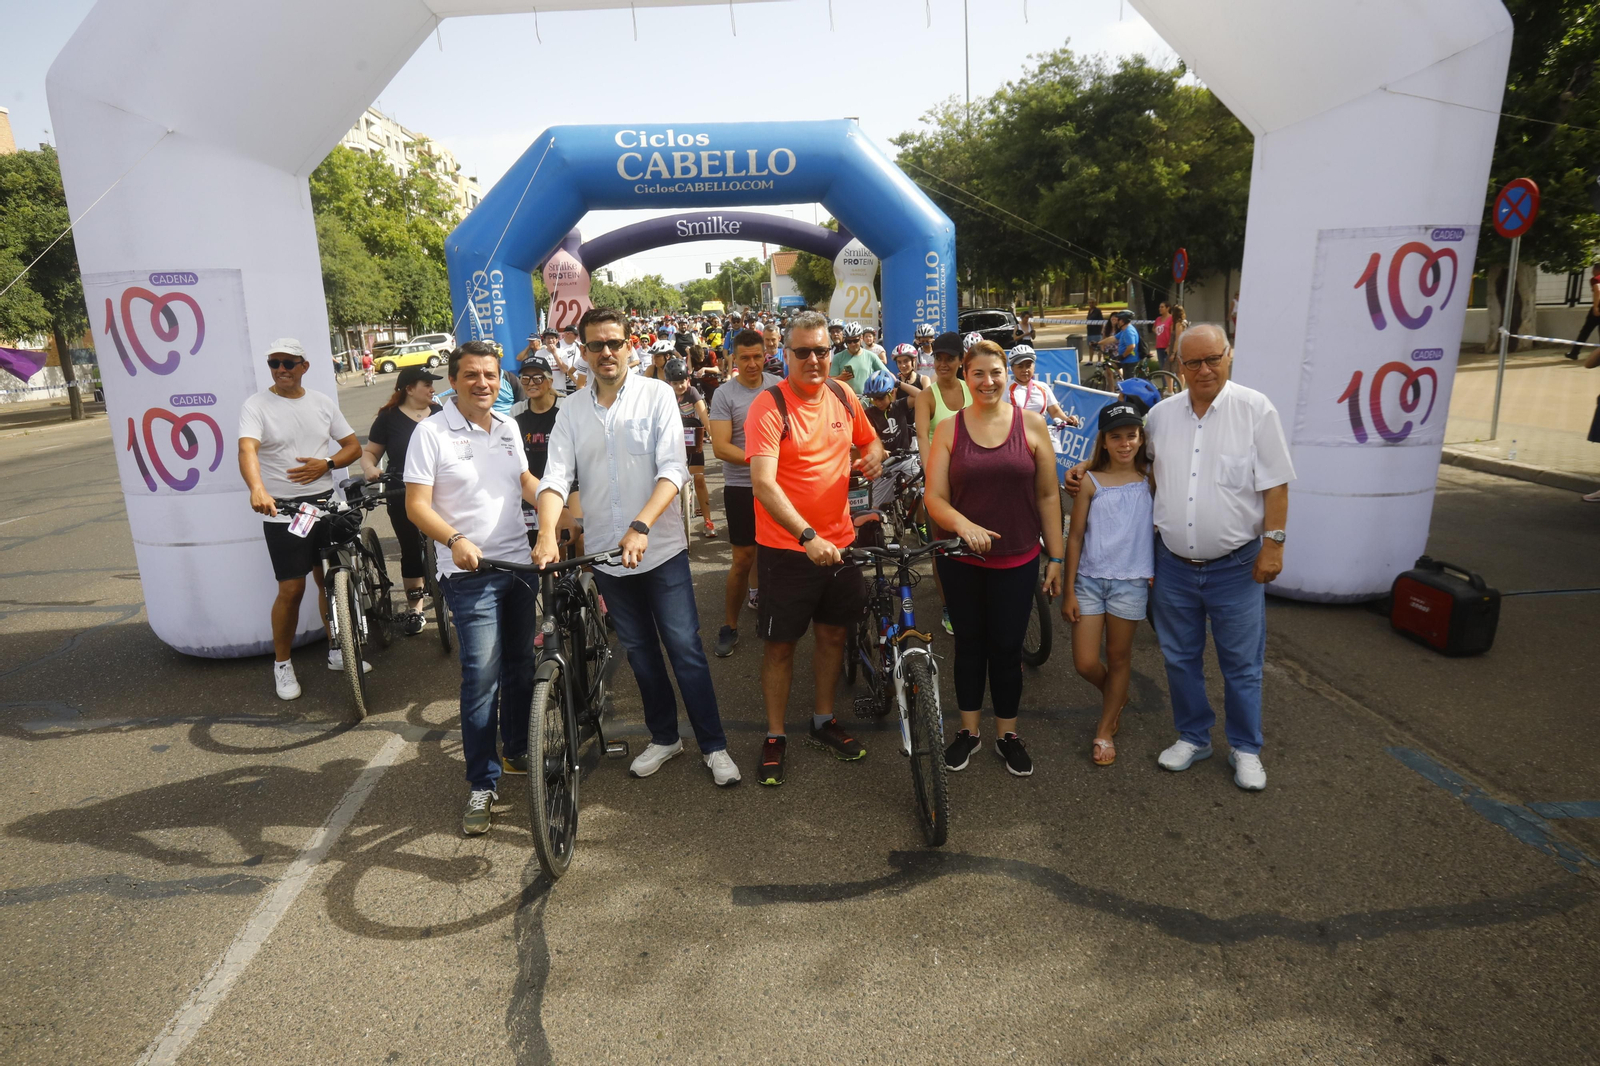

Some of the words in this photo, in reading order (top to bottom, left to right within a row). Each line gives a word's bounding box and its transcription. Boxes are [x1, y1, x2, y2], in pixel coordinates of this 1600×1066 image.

[614, 129, 710, 148] Ciclos
[616, 147, 797, 181] CABELLO
[634, 180, 774, 194] CiclosCABELLO.COM
[676, 216, 740, 237] Smilke
[1431, 229, 1464, 240] CADENA
[844, 248, 873, 257] Smilke
[548, 262, 578, 271] Smilke
[151, 274, 196, 285] CADENA
[548, 271, 580, 280] PROTEIN
[489, 269, 506, 325] Ciclos
[844, 285, 873, 318] 22
[925, 251, 940, 337] ABELLO
[472, 270, 494, 341] CABEL
[555, 299, 582, 333] 22
[1412, 350, 1443, 360] CADENA
[172, 395, 215, 405] CADENA
